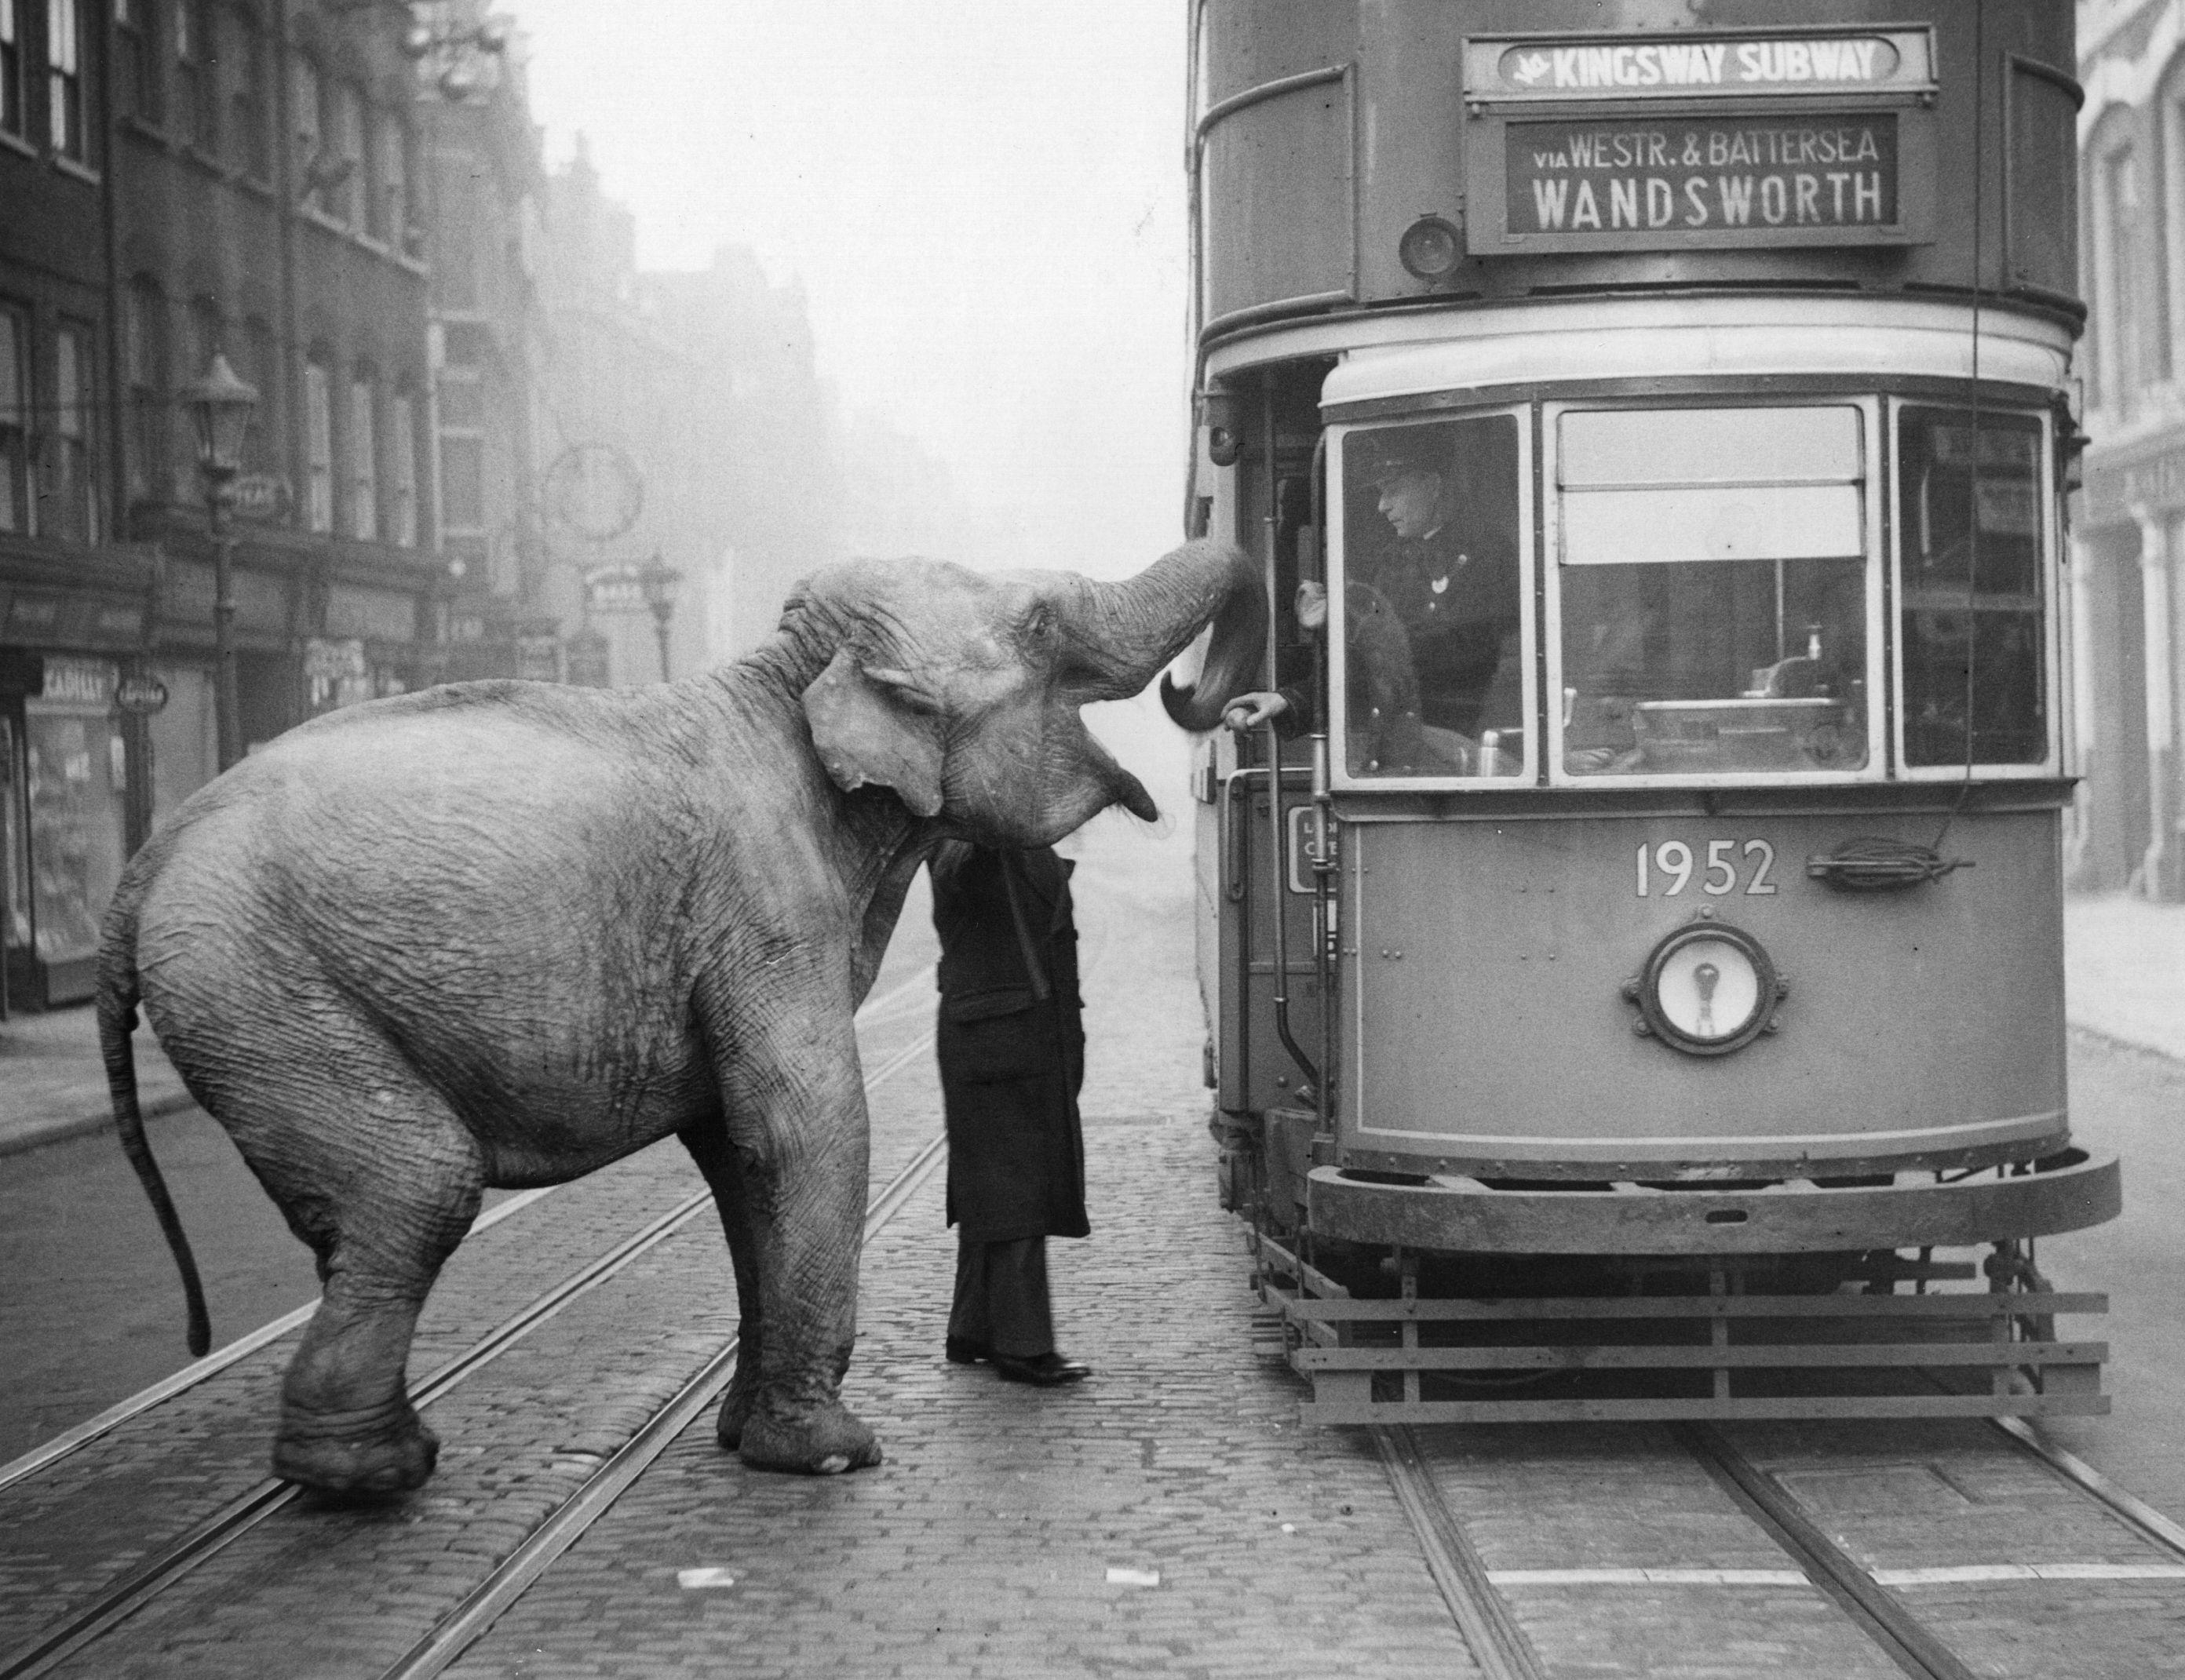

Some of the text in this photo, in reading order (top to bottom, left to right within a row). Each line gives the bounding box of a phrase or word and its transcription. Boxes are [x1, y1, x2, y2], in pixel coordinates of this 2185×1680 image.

[1552, 44, 1727, 87] KINGSWAY
[1737, 42, 1876, 82] SUBWAY
[1533, 129, 1879, 168] VIA WESTR. & BATTERSEA
[1533, 171, 1881, 230] WANDSWORTH
[1636, 838, 1777, 897] 1952
